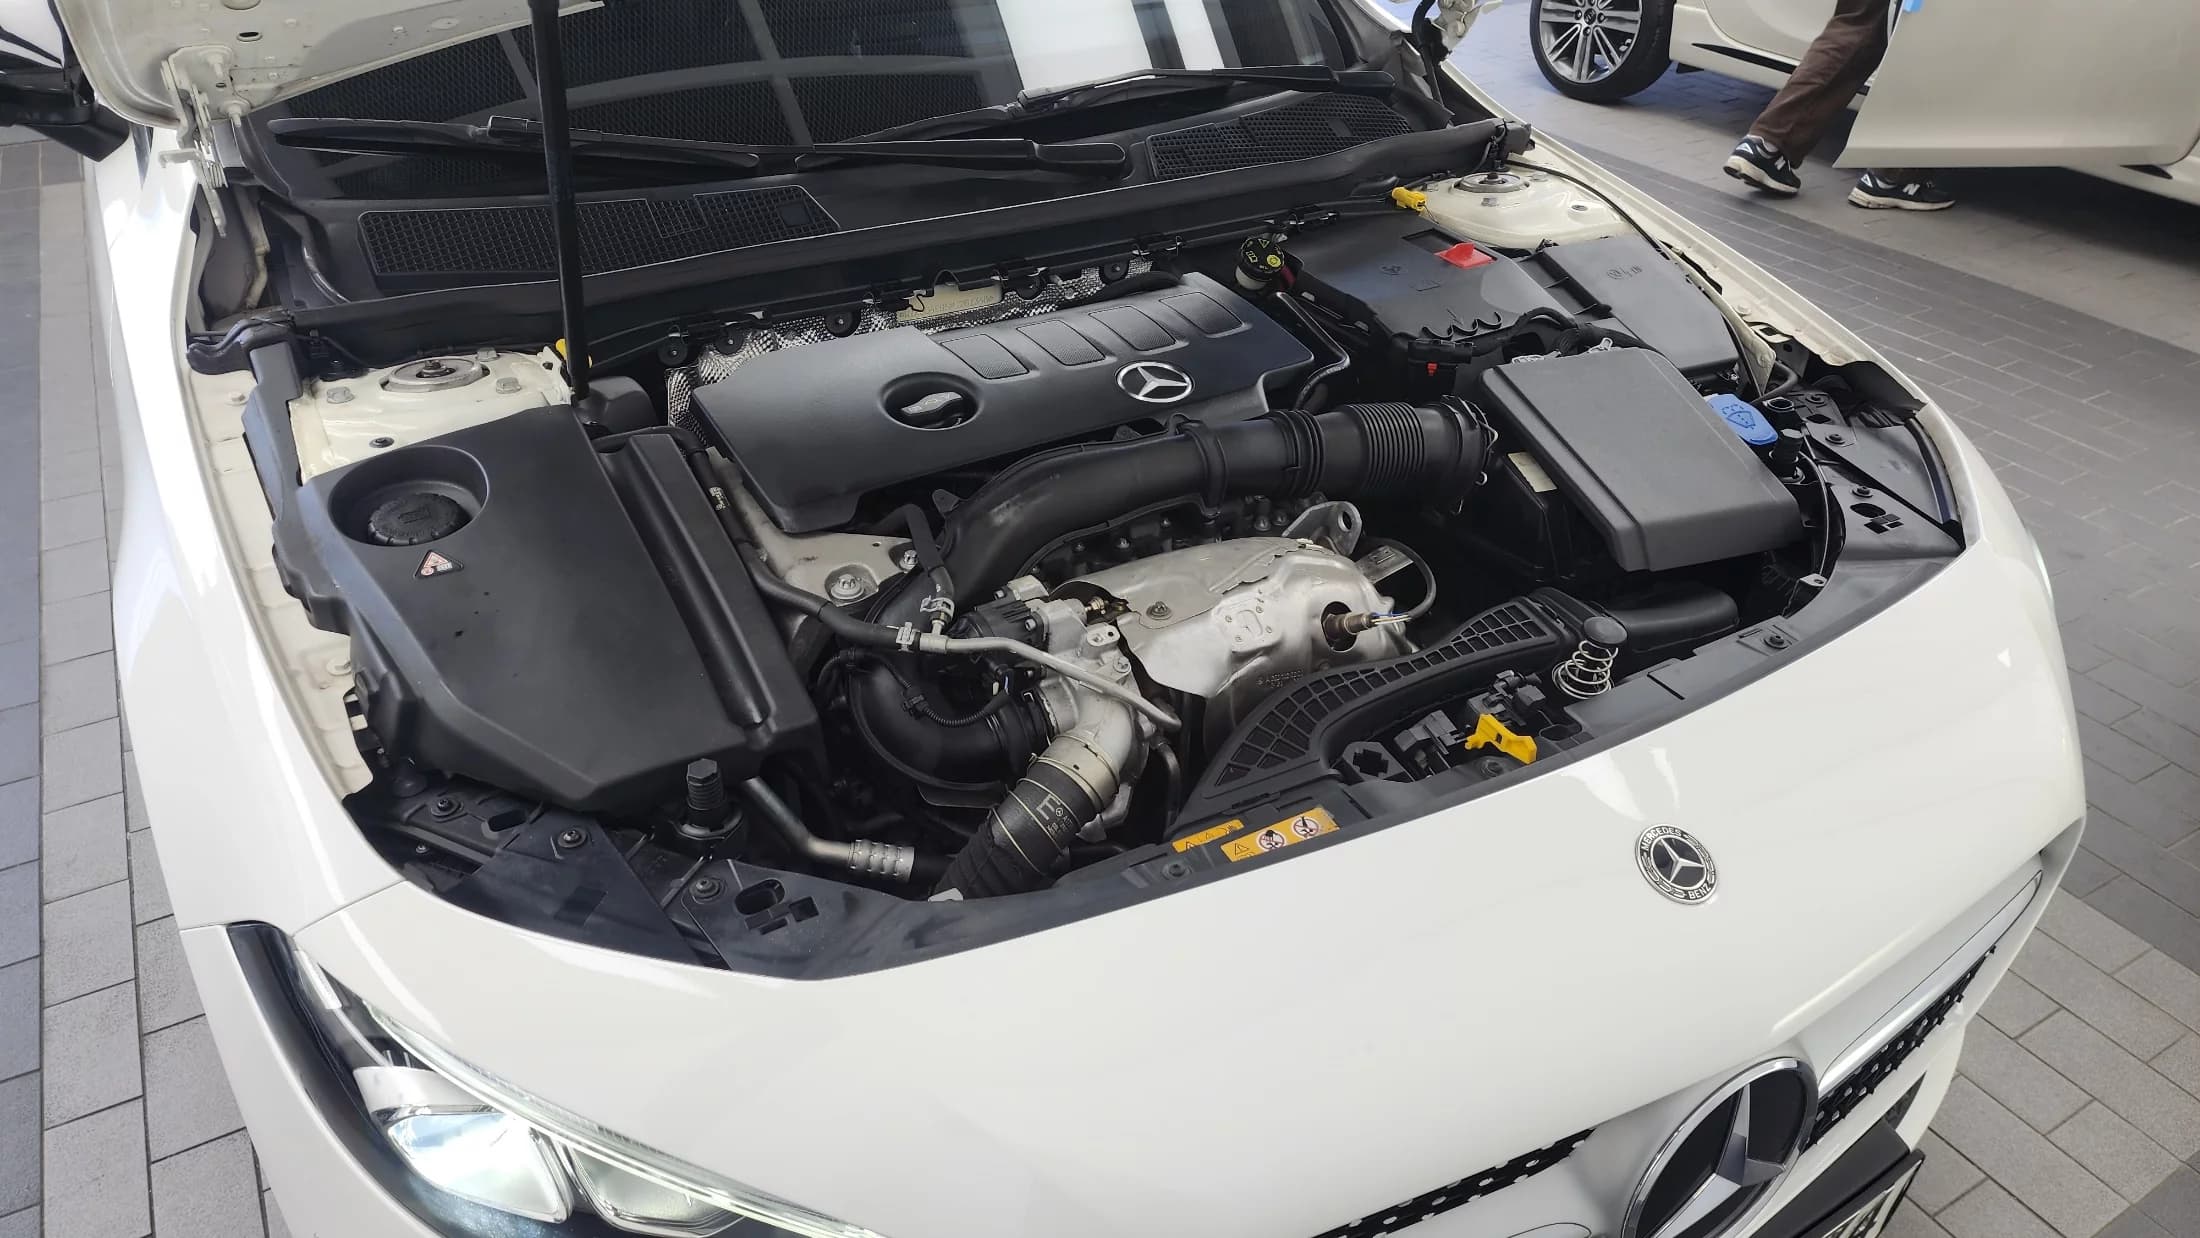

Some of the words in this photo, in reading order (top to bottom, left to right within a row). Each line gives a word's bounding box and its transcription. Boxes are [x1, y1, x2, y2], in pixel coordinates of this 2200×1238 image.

[1902, 183, 1920, 196] N
[1640, 826, 1682, 852] MERCEDES
[1687, 884, 1711, 900] BENZ
